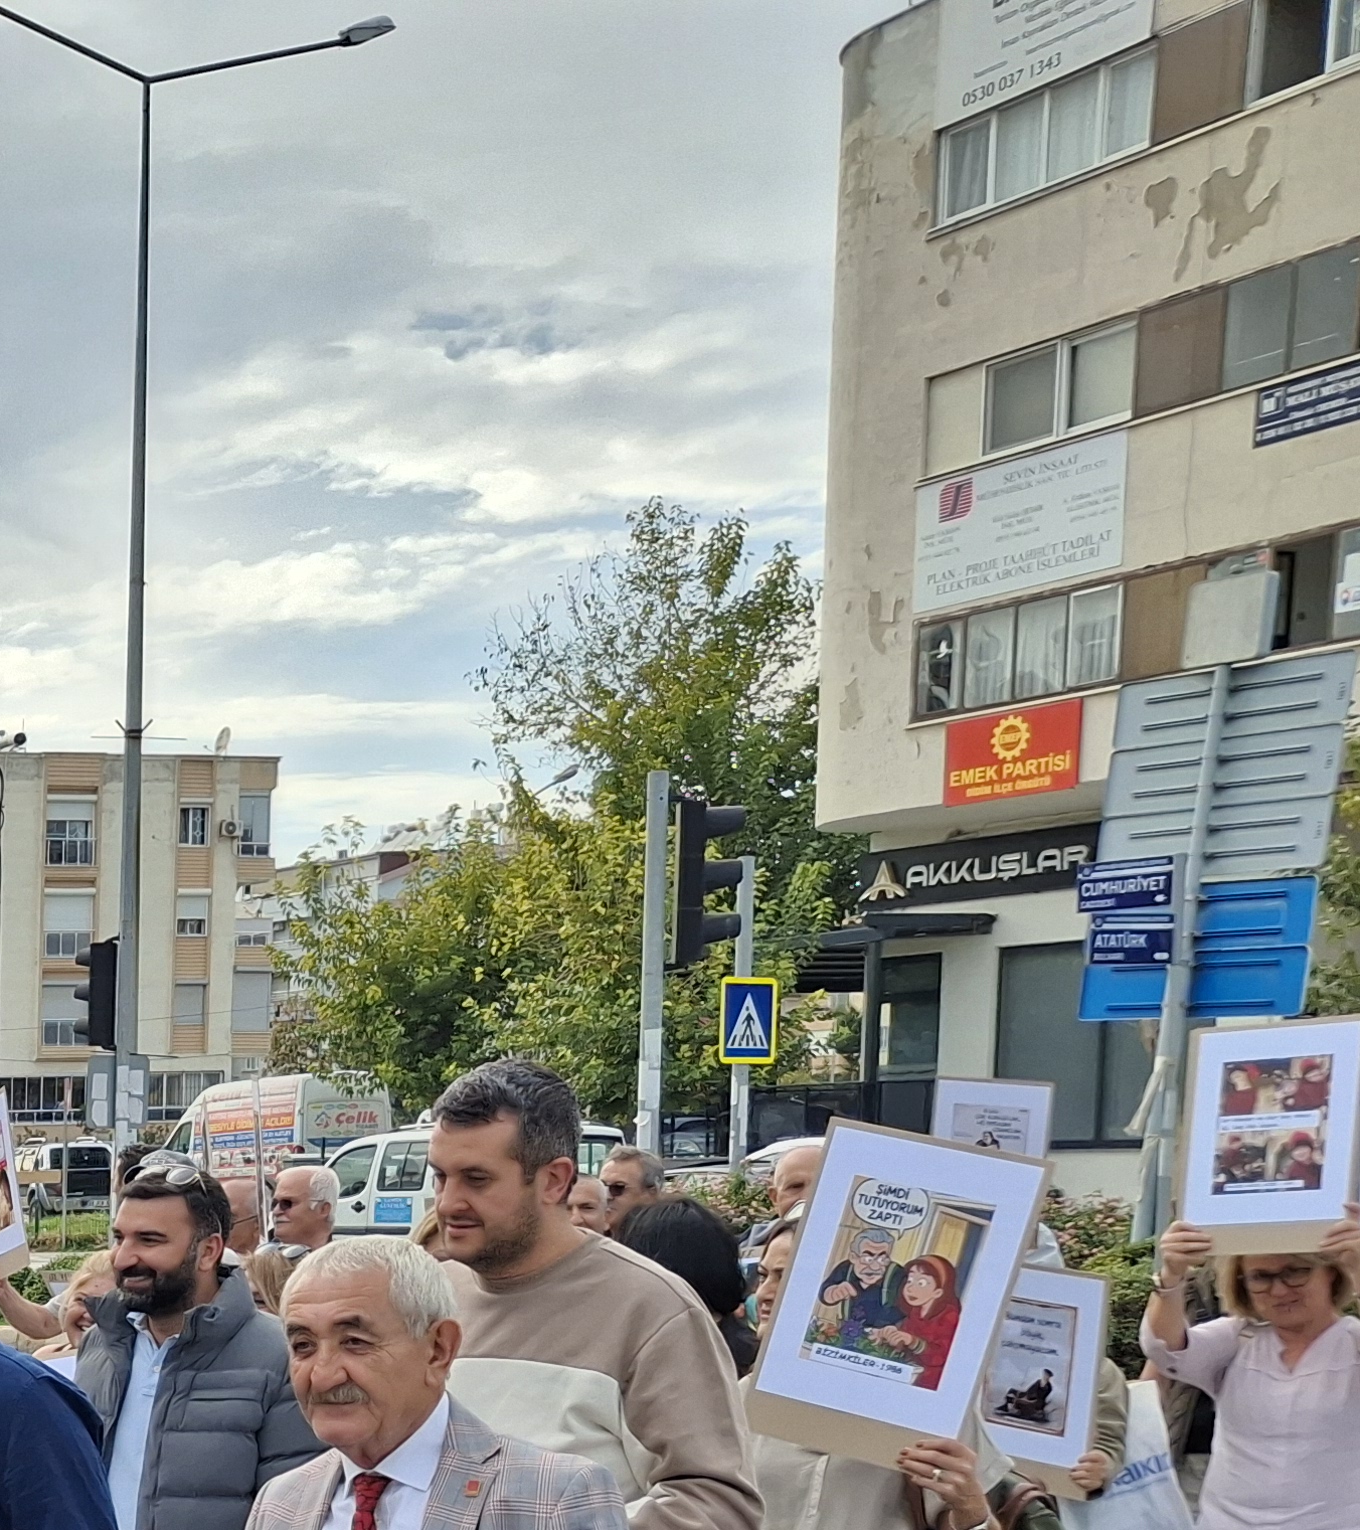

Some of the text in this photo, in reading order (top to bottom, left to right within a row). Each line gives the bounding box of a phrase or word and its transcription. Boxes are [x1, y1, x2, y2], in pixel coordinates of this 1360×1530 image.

[962, 81, 995, 107] 0530
[998, 68, 1025, 92] 037
[1029, 52, 1062, 79] 1343
[927, 568, 955, 586] PLAN
[965, 558, 999, 577] PROJE
[994, 562, 1033, 582] ABONE
[949, 749, 1071, 788] EMEK PARTİSİ
[905, 844, 1090, 889] AKKUŞLAR
[1080, 875, 1168, 898] CUMHURİYET
[1093, 931, 1148, 949] ATATÜRK
[335, 1110, 379, 1128] Çelik
[875, 1183, 911, 1201] ŞİMDİ
[858, 1193, 925, 1217] TUTUYORUM
[866, 1208, 904, 1226] ZAPTI
